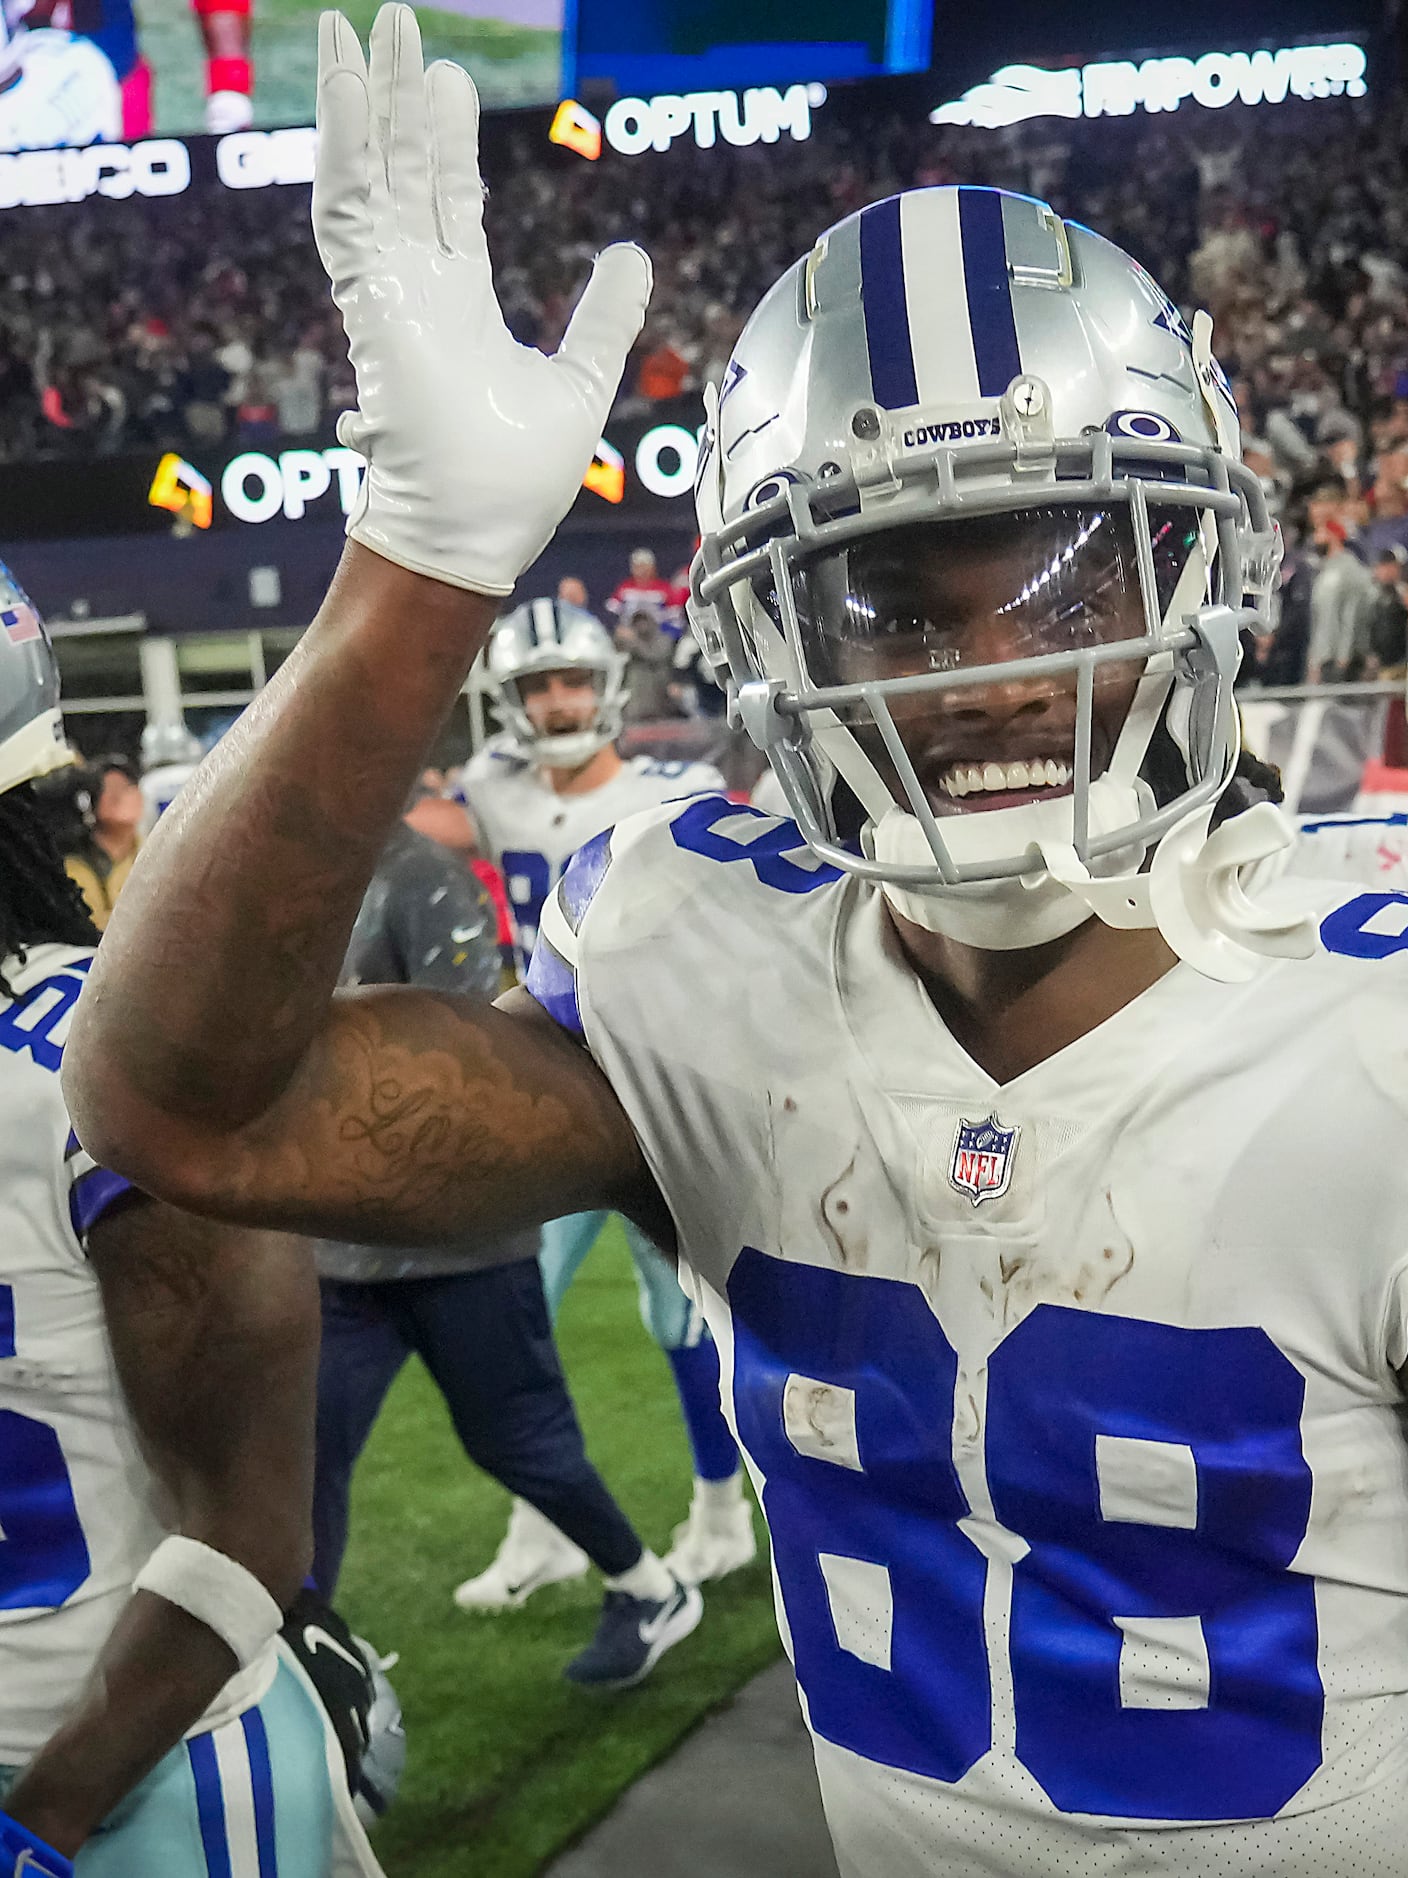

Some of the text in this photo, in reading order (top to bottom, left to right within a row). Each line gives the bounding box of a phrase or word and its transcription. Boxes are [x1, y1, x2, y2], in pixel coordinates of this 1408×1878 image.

[605, 84, 812, 155] OPTUM
[904, 417, 1000, 447] COWBOYS
[221, 447, 366, 524] OPT
[957, 1151, 1000, 1188] NFL
[726, 1246, 1325, 1821] 88
